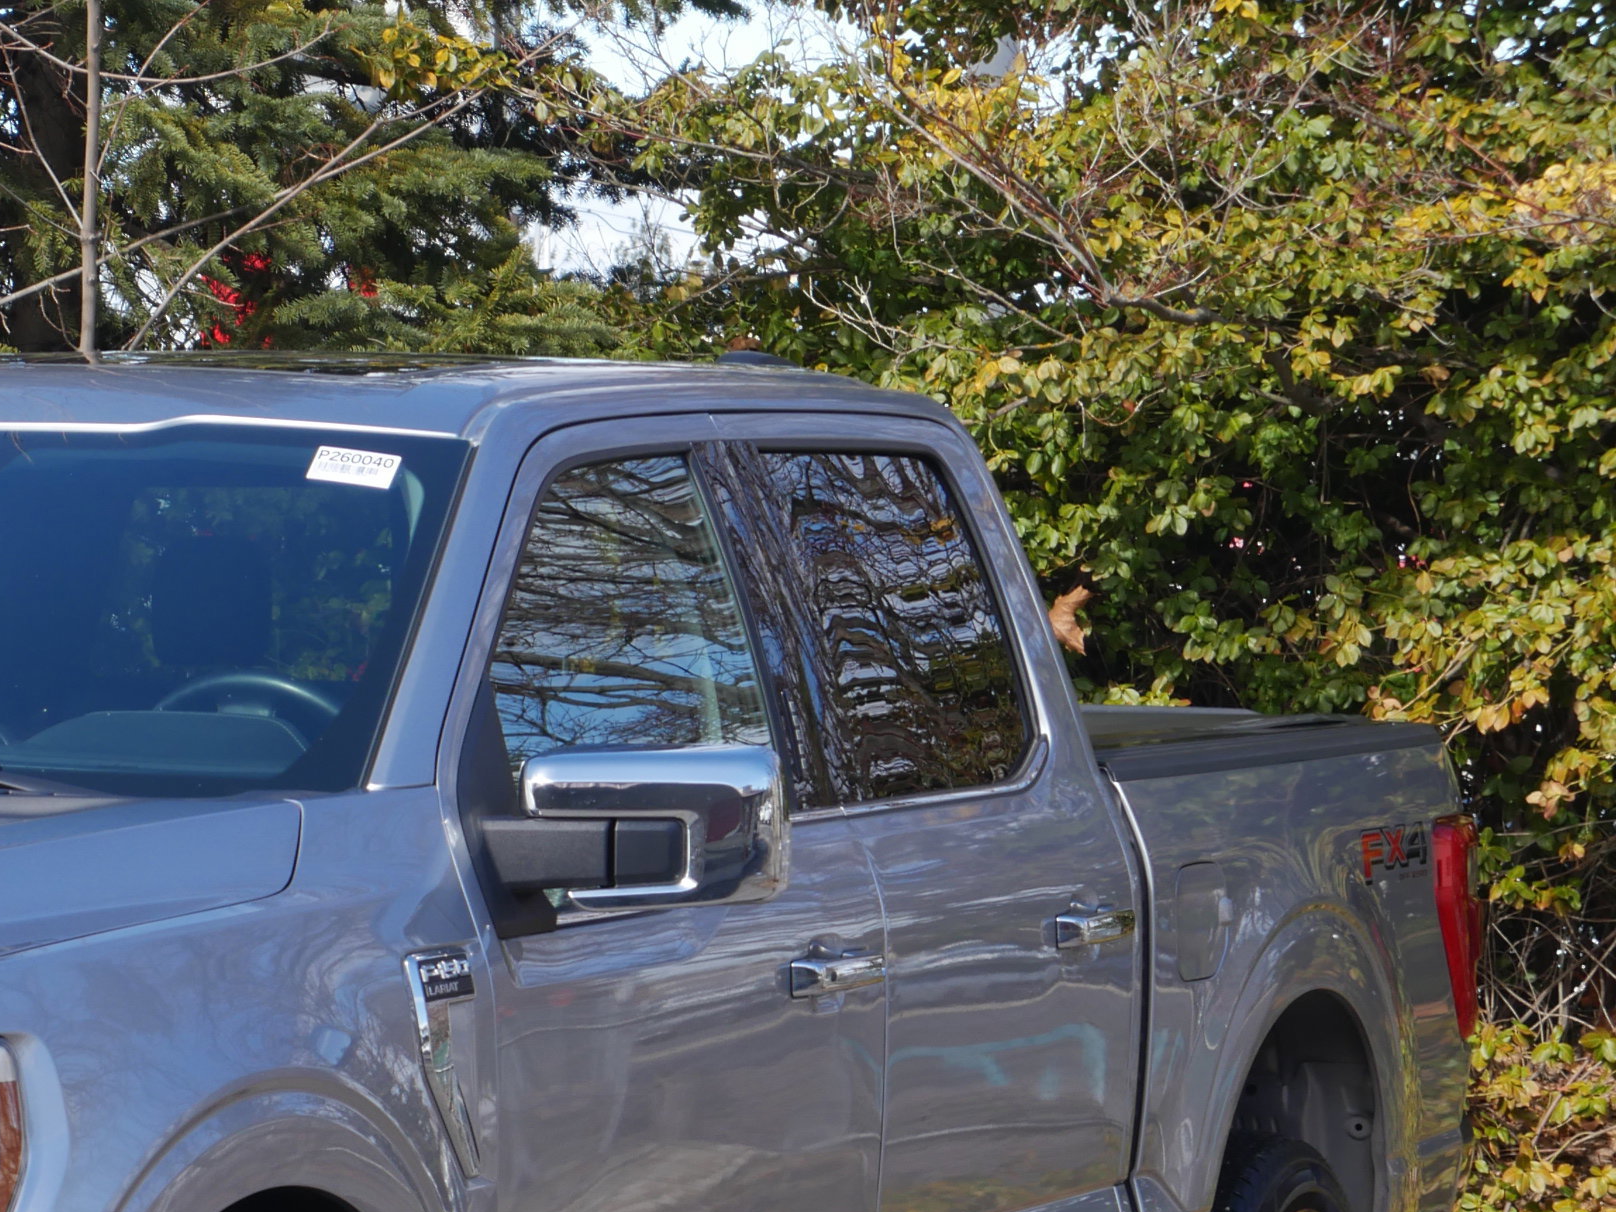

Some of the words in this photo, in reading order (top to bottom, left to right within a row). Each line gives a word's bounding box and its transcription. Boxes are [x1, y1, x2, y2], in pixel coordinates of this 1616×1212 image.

[318, 449, 394, 469] P260040
[1361, 822, 1427, 885] FX4
[428, 982, 460, 996] LARIAT
